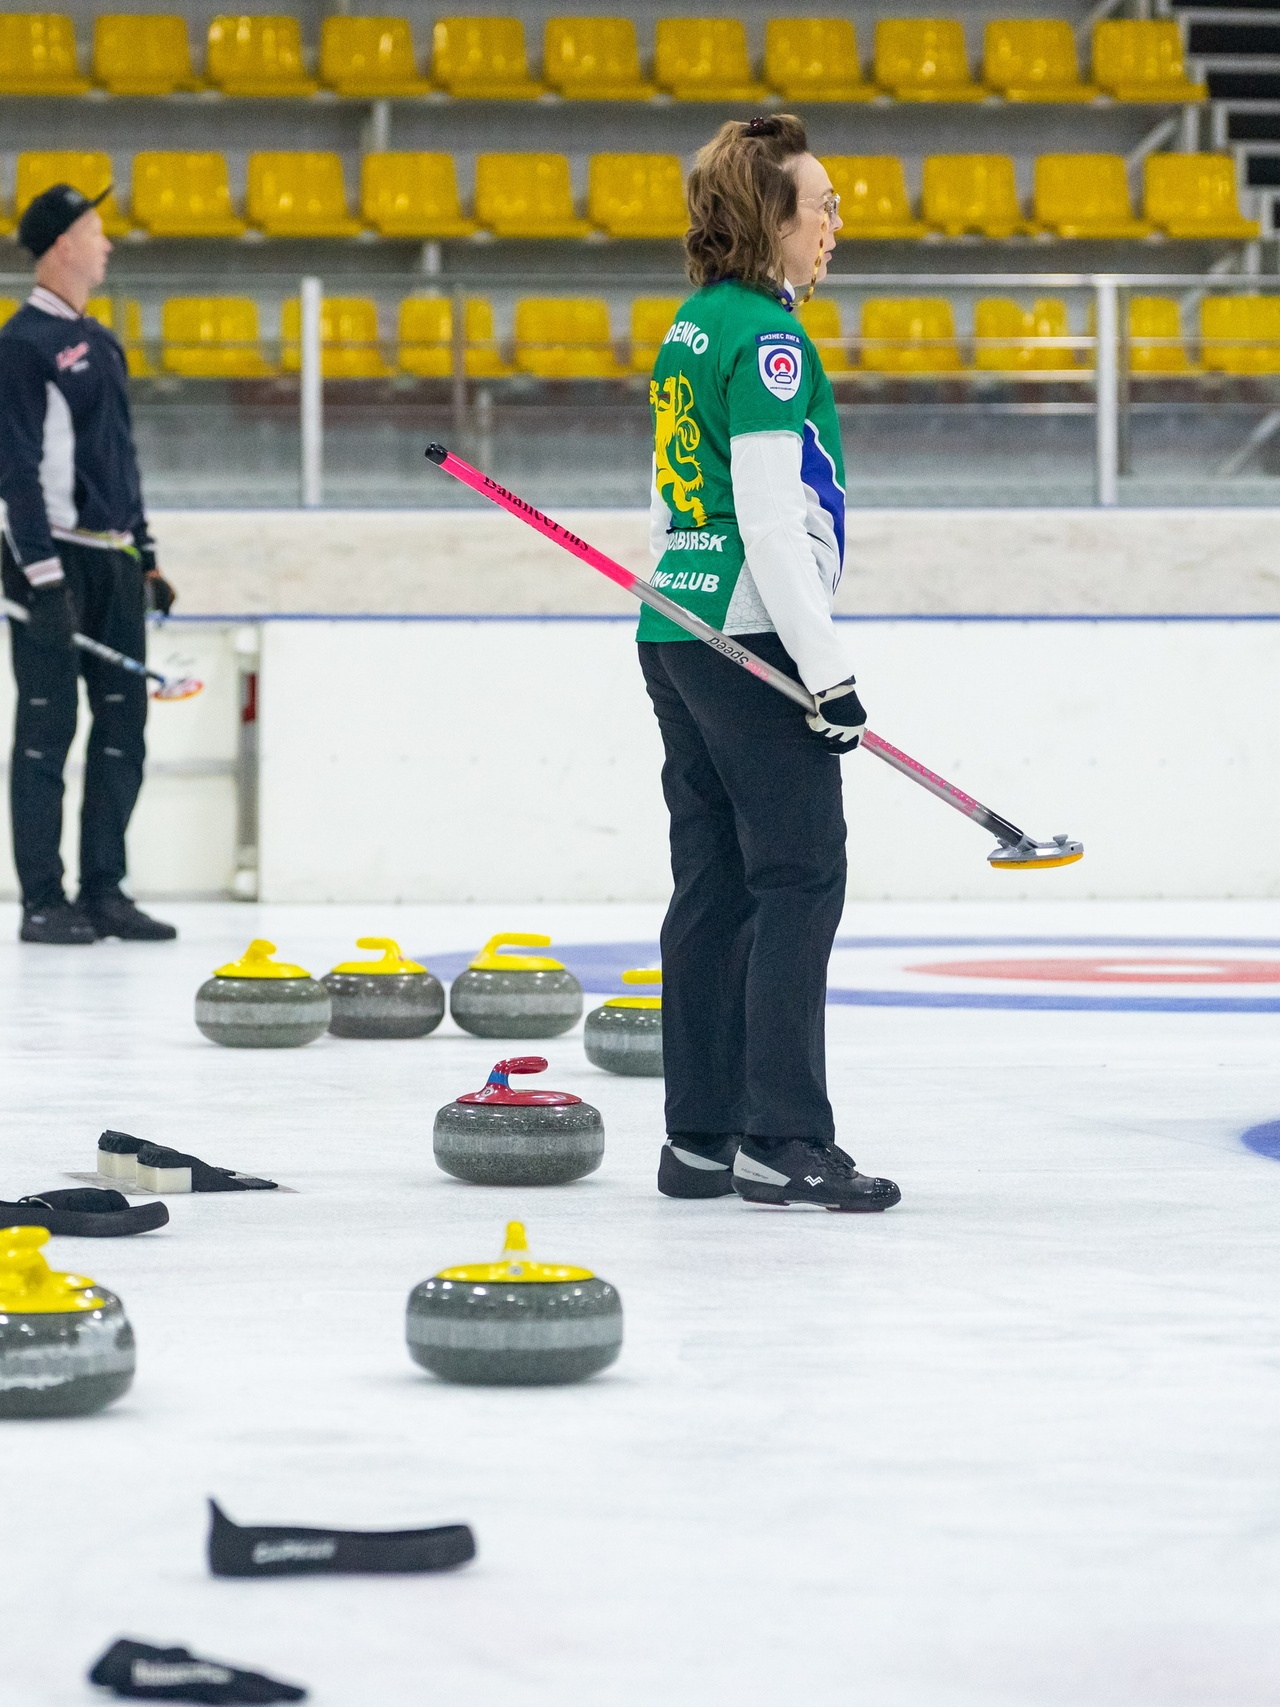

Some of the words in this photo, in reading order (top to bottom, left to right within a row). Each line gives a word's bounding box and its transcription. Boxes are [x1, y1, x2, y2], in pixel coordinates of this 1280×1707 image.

[760, 333, 784, 342] БИЗНЕС
[786, 334, 800, 343] ЛИГА
[671, 572, 720, 593] CLUB
